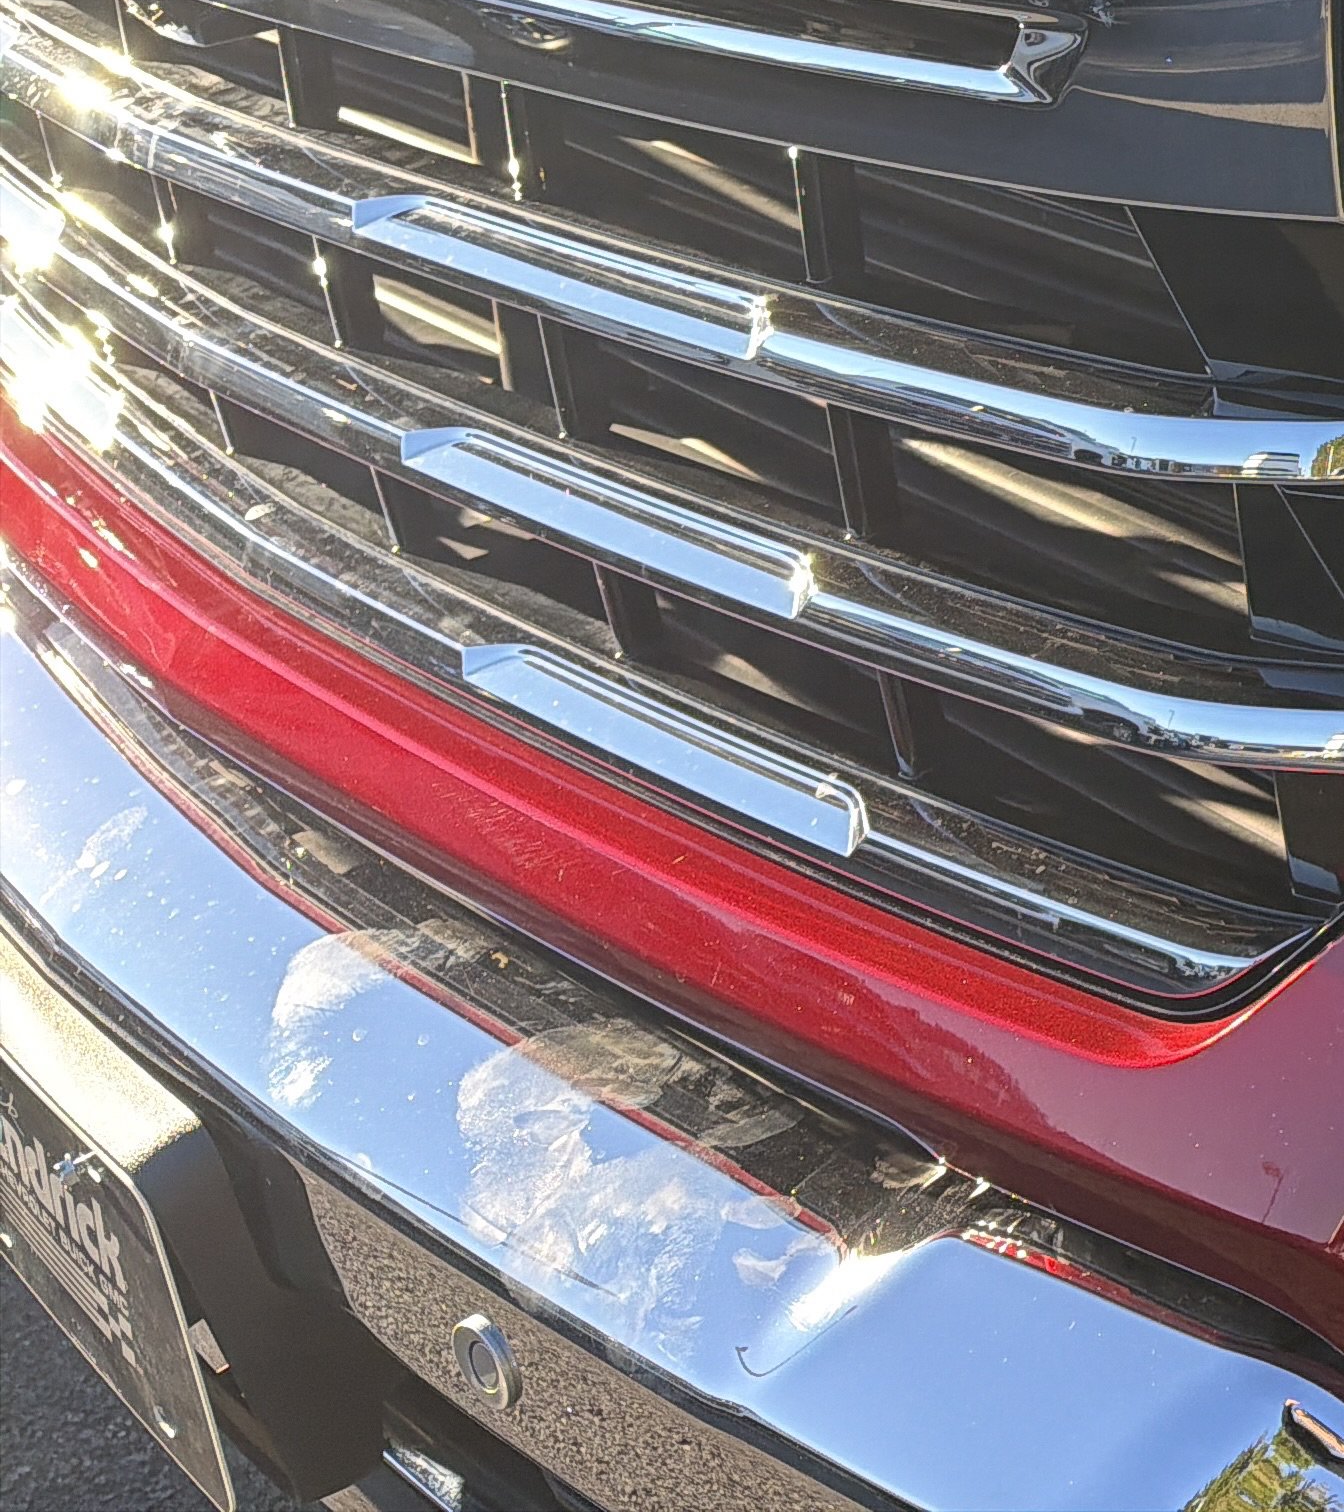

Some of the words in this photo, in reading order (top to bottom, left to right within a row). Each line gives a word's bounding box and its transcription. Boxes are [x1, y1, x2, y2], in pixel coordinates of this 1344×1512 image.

[0, 1115, 126, 1295] ndrick
[59, 1227, 98, 1284] BUICK
[99, 1273, 130, 1318] GMC
